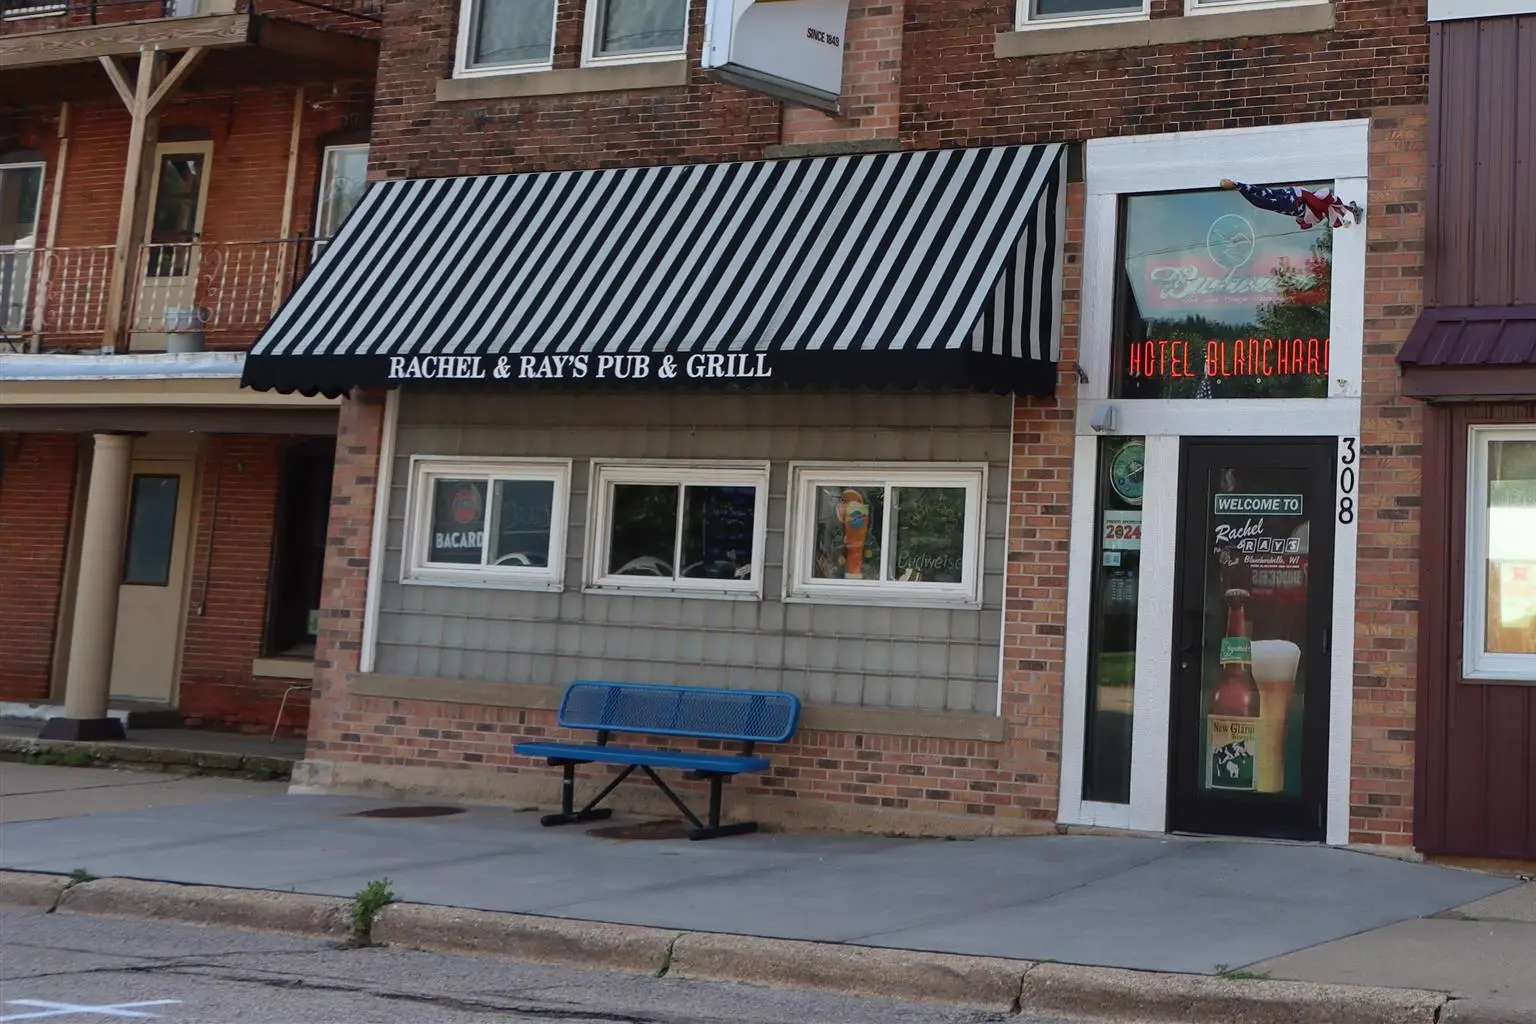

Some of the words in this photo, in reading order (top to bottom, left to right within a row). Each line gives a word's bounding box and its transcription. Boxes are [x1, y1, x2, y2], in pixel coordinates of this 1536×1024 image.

[806, 27, 826, 43] SINCE
[388, 355, 486, 379] RACHEL
[492, 355, 512, 380] &
[518, 353, 590, 379] RAY'S
[595, 354, 651, 379] PUB
[657, 354, 679, 379] &
[685, 352, 773, 379] GRILL
[1130, 340, 1196, 377] HOTEL
[1338, 437, 1356, 525] 308
[1219, 498, 1281, 511] WELCOME
[1283, 498, 1299, 511] TO
[1214, 517, 1264, 544] Rachel
[1244, 538, 1299, 553] RAY'S
[1289, 556, 1300, 564] WI
